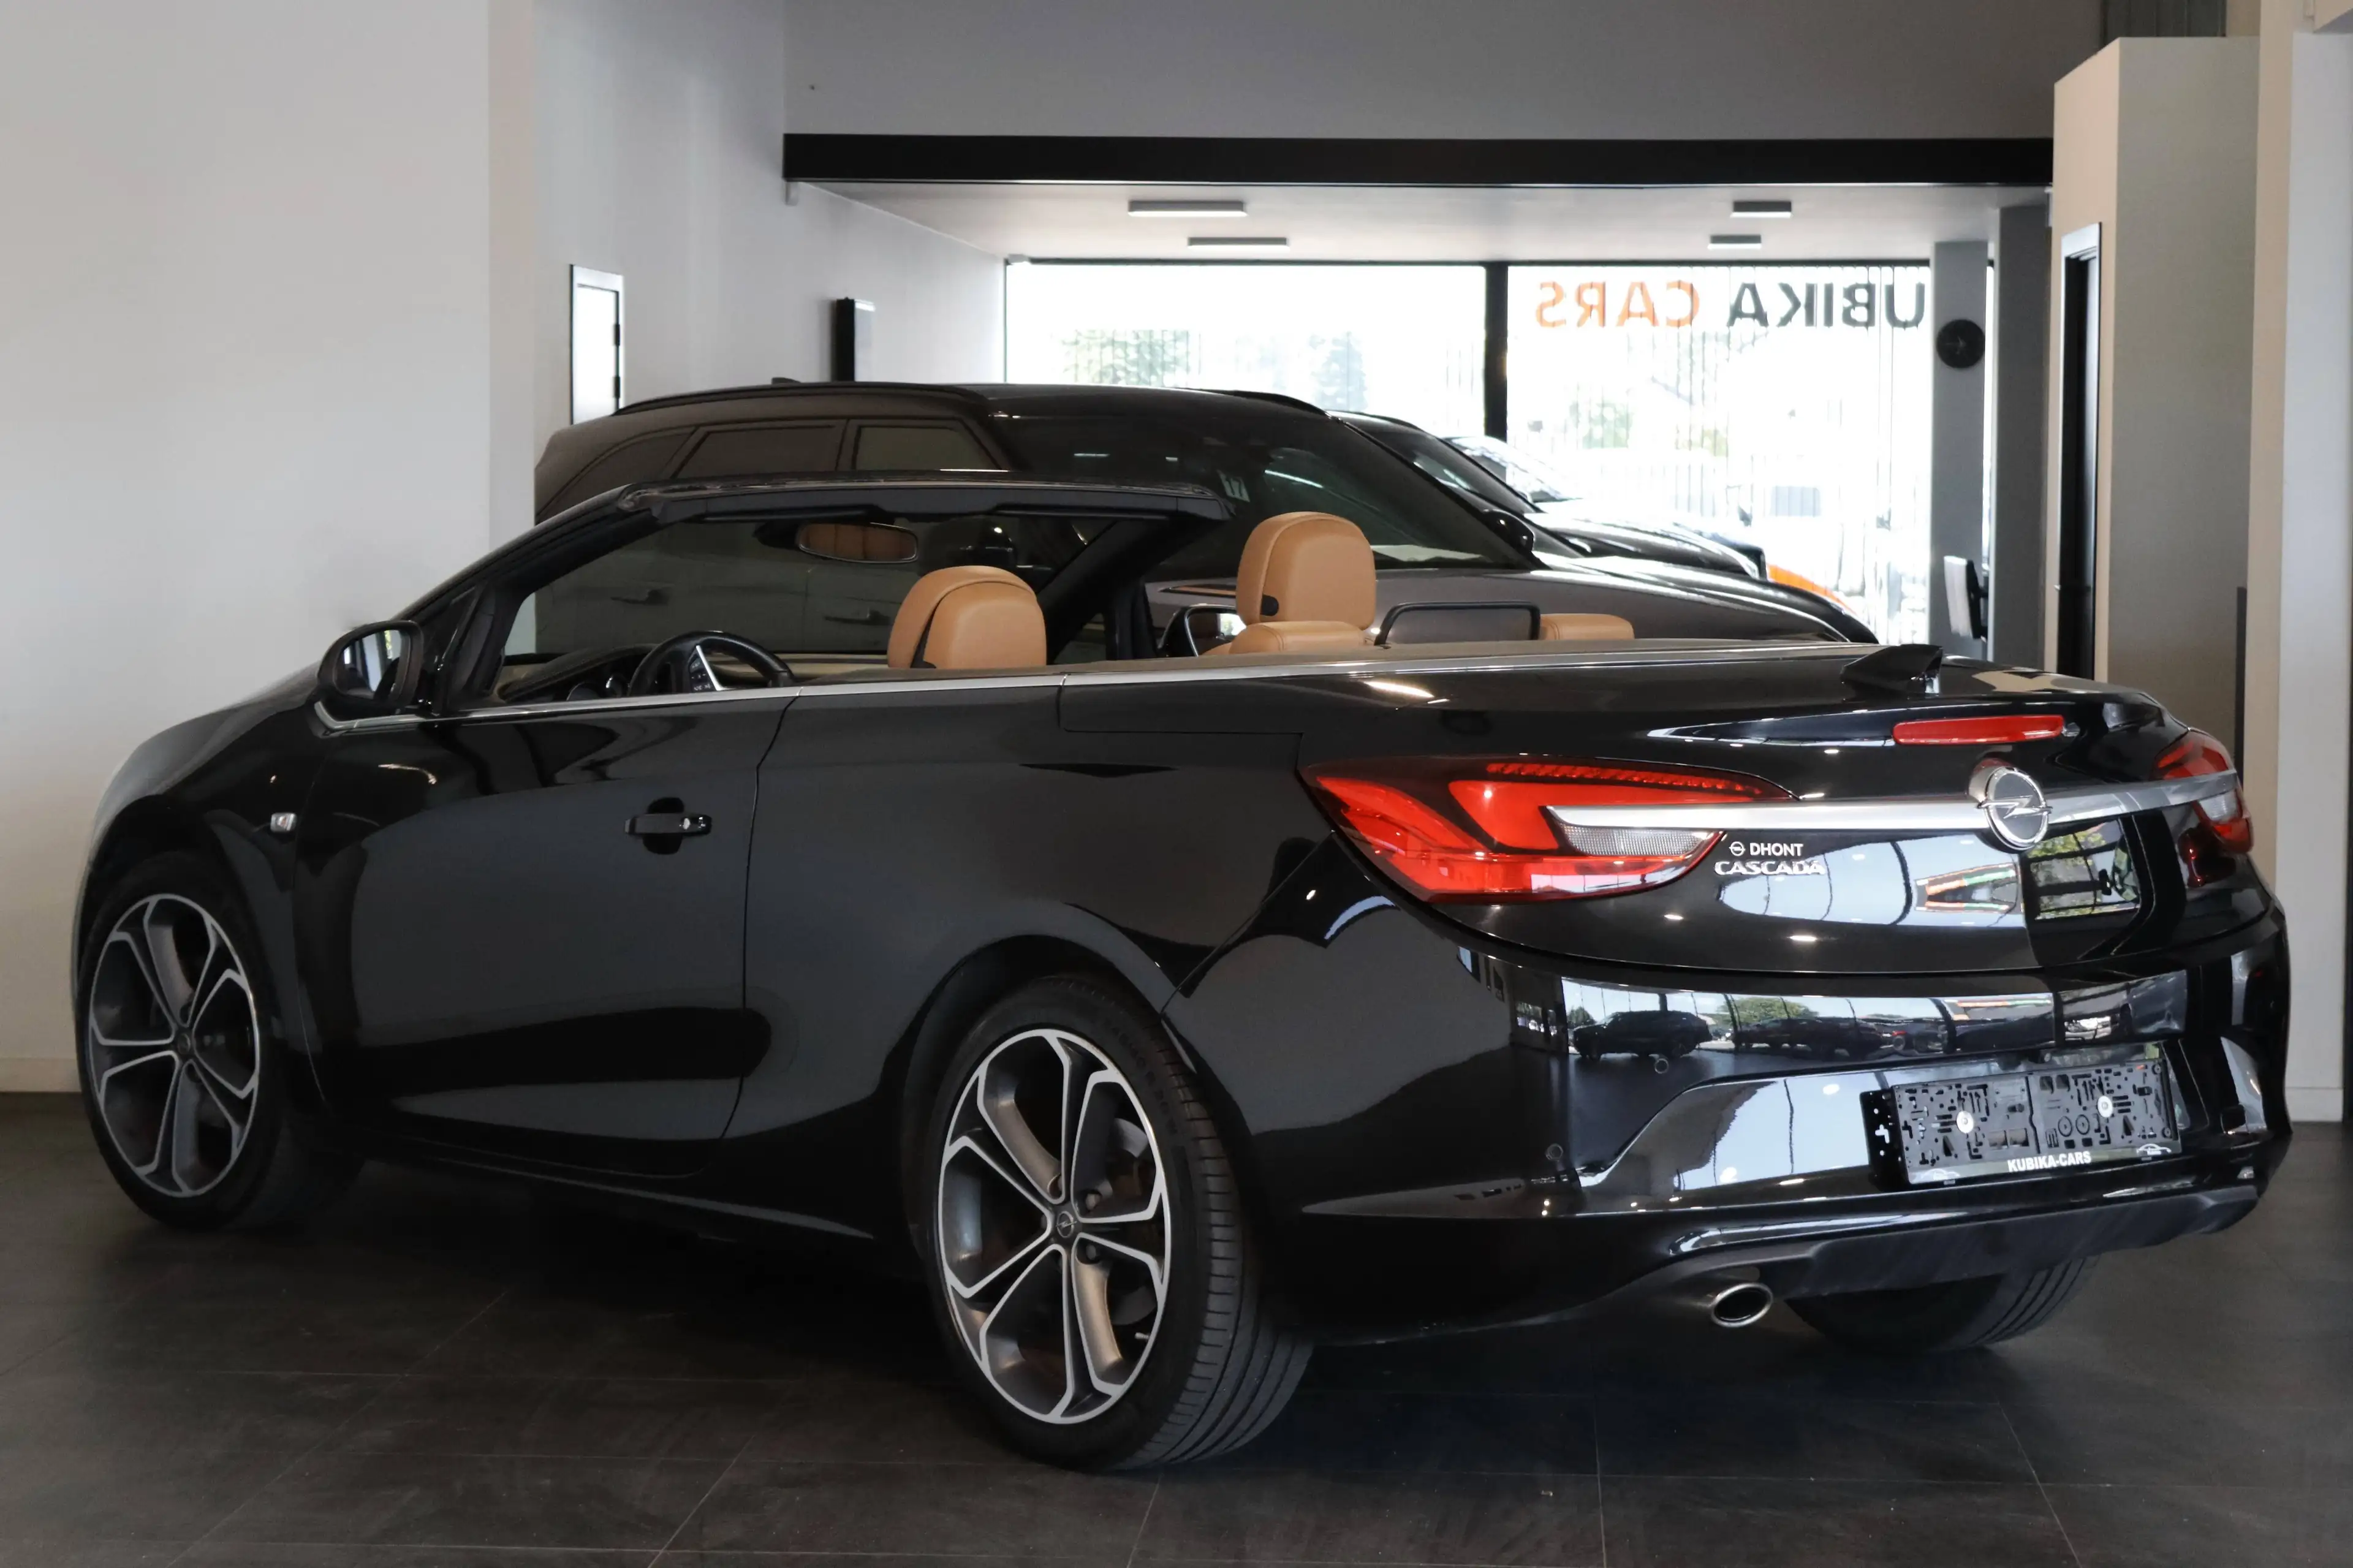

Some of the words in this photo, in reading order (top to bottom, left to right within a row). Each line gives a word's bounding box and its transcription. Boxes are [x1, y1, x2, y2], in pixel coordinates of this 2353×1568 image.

[1749, 843, 1803, 856] DHONT
[1714, 860, 1826, 875] CASCADA
[2007, 1150, 2092, 1173] KUBIKA-CARS
